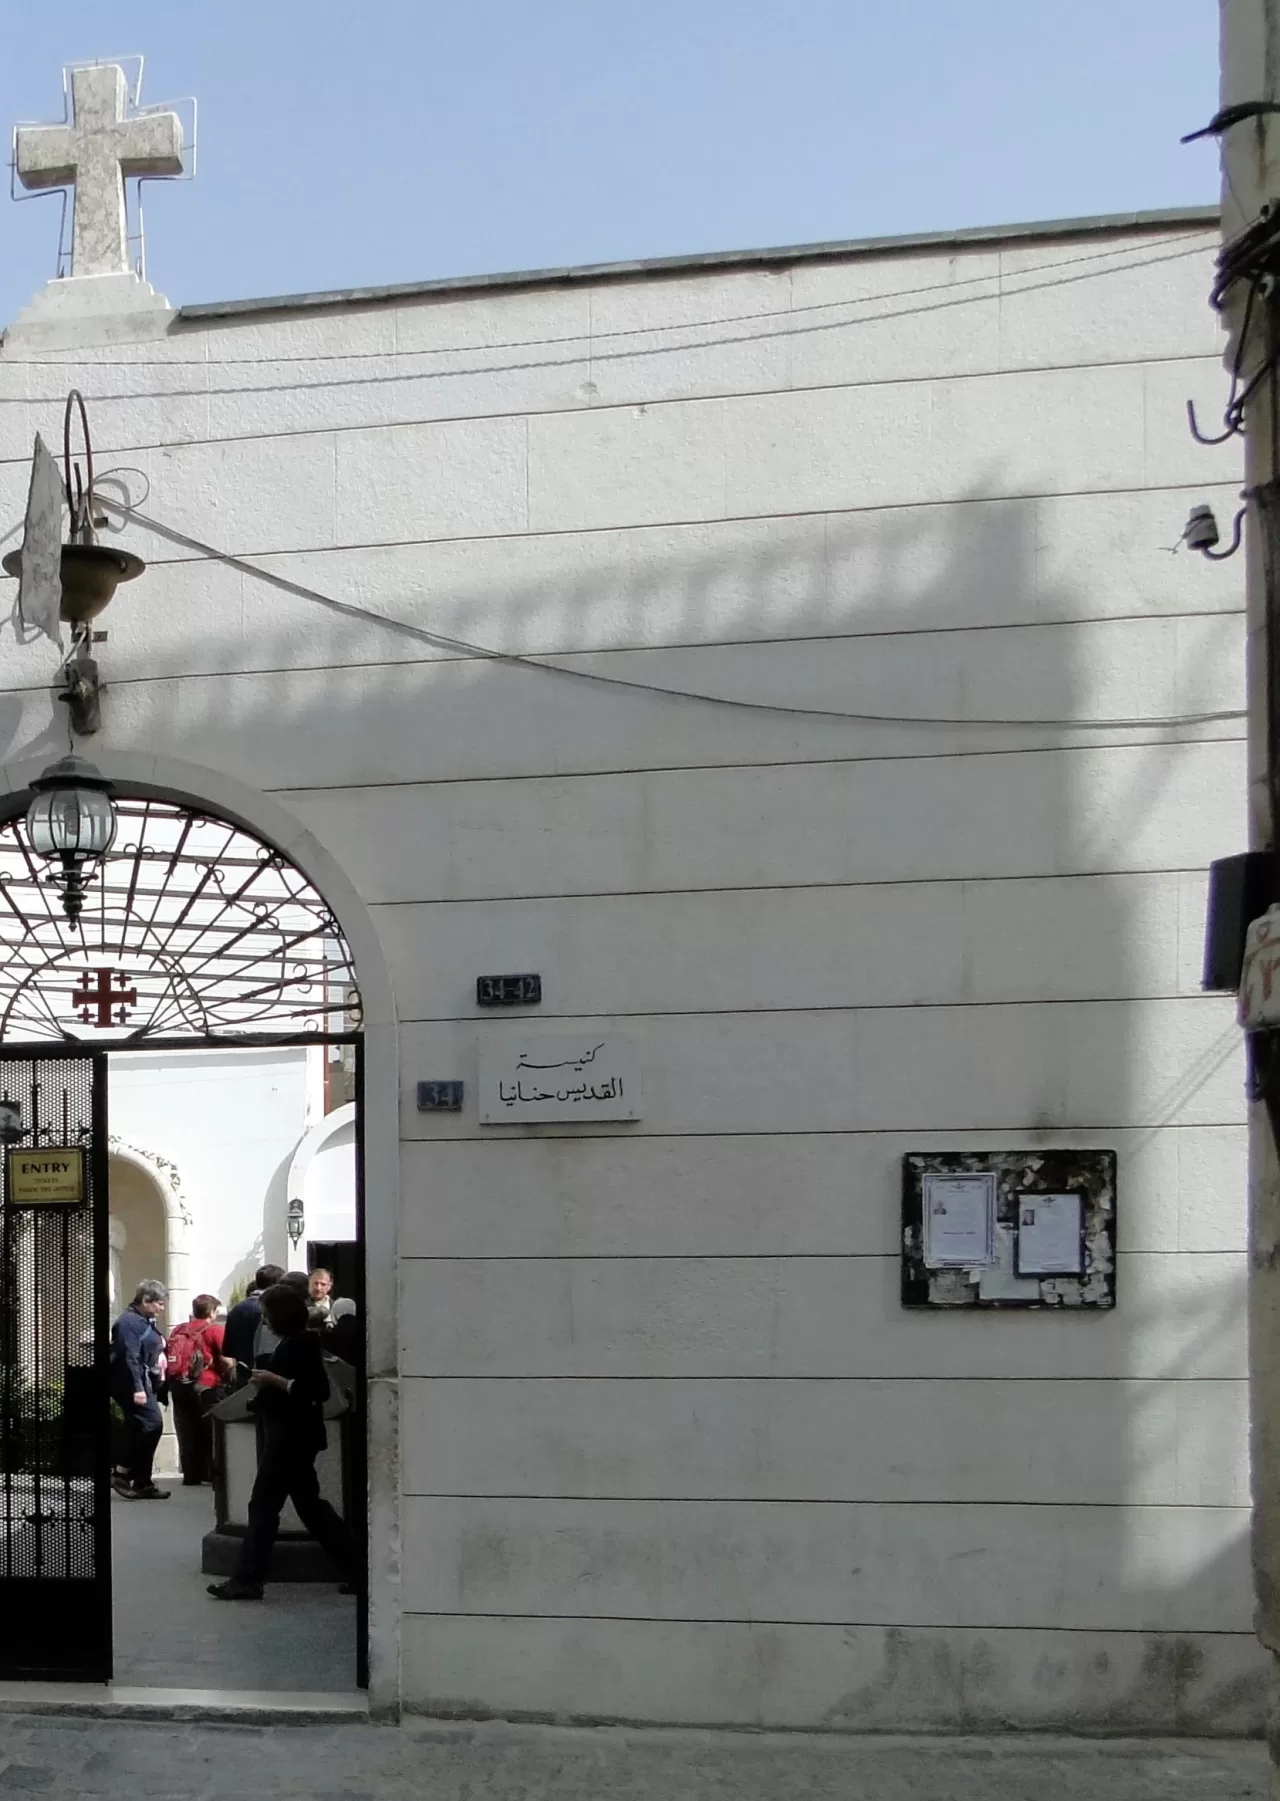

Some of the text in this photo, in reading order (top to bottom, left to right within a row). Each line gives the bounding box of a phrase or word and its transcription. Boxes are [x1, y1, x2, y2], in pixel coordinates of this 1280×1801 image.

[482, 978, 536, 1000] 34-42
[516, 1042, 605, 1071] كنيسة
[499, 1077, 623, 1106] القديس حنانيا
[21, 1162, 69, 1174] ENTRY
